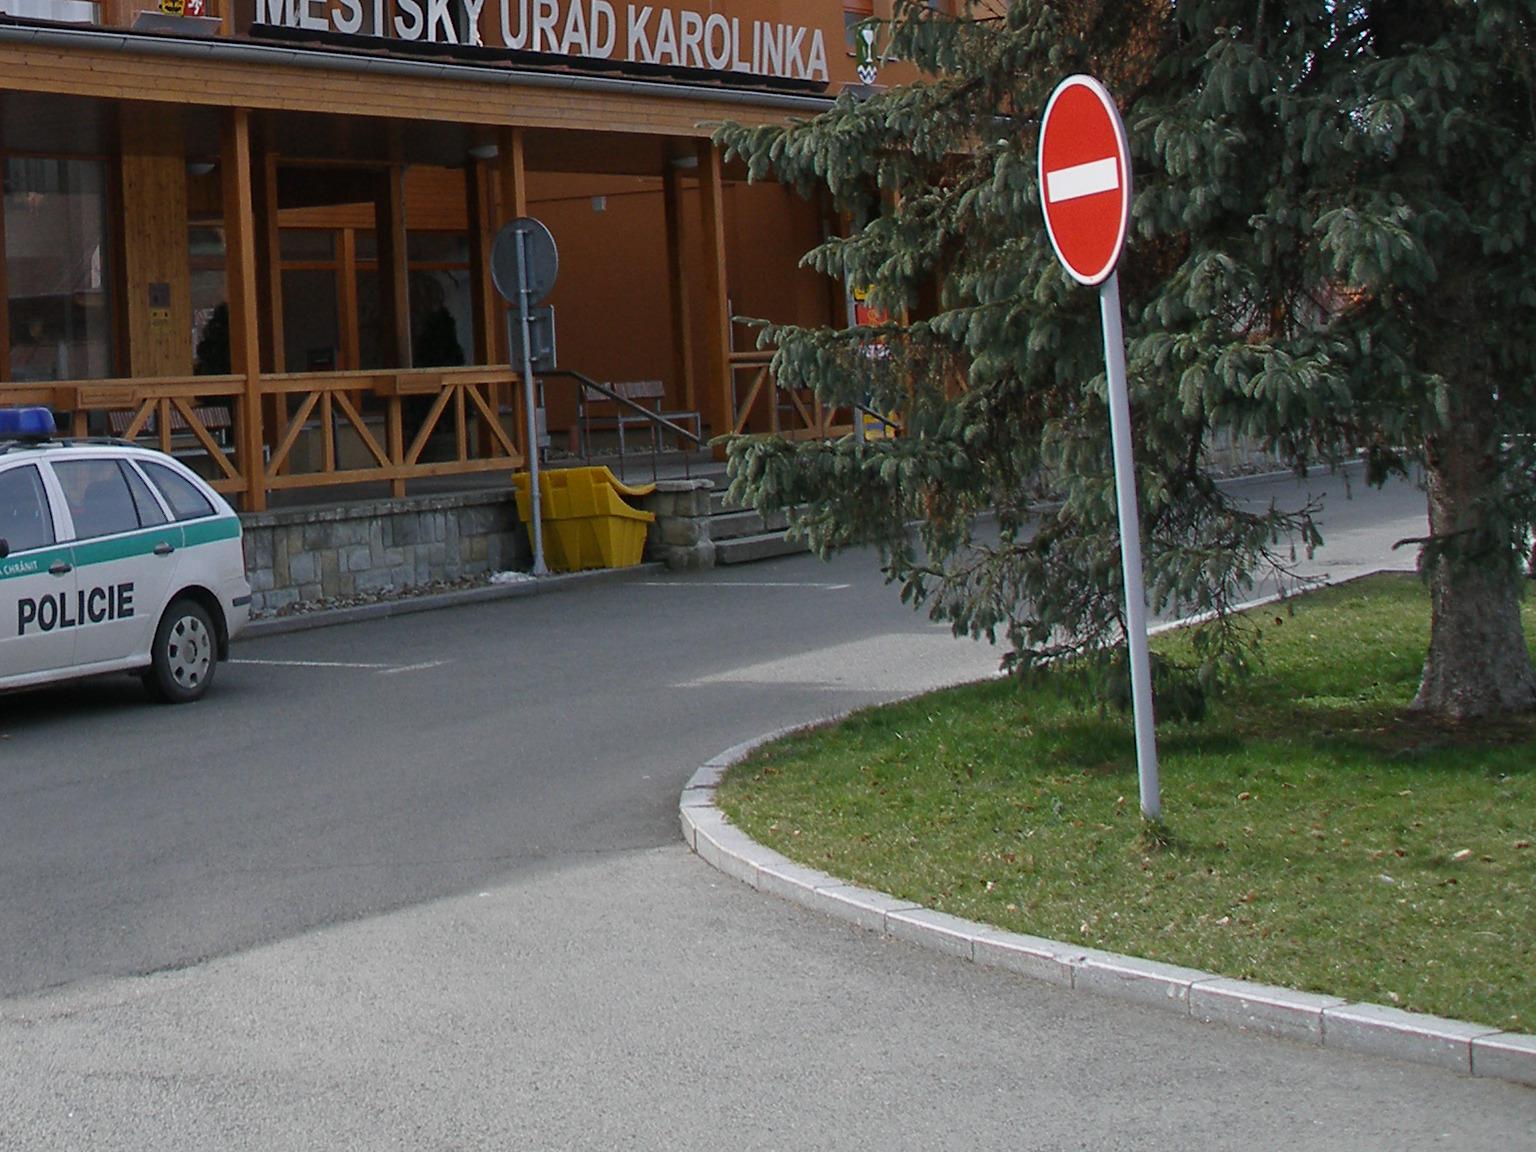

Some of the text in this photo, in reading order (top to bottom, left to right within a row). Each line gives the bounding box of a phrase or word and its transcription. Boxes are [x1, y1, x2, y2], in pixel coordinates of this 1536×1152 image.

[624, 3, 830, 83] KAROLINKA
[4, 560, 39, 576] CHRÁNIT
[18, 582, 135, 636] POLICIE
